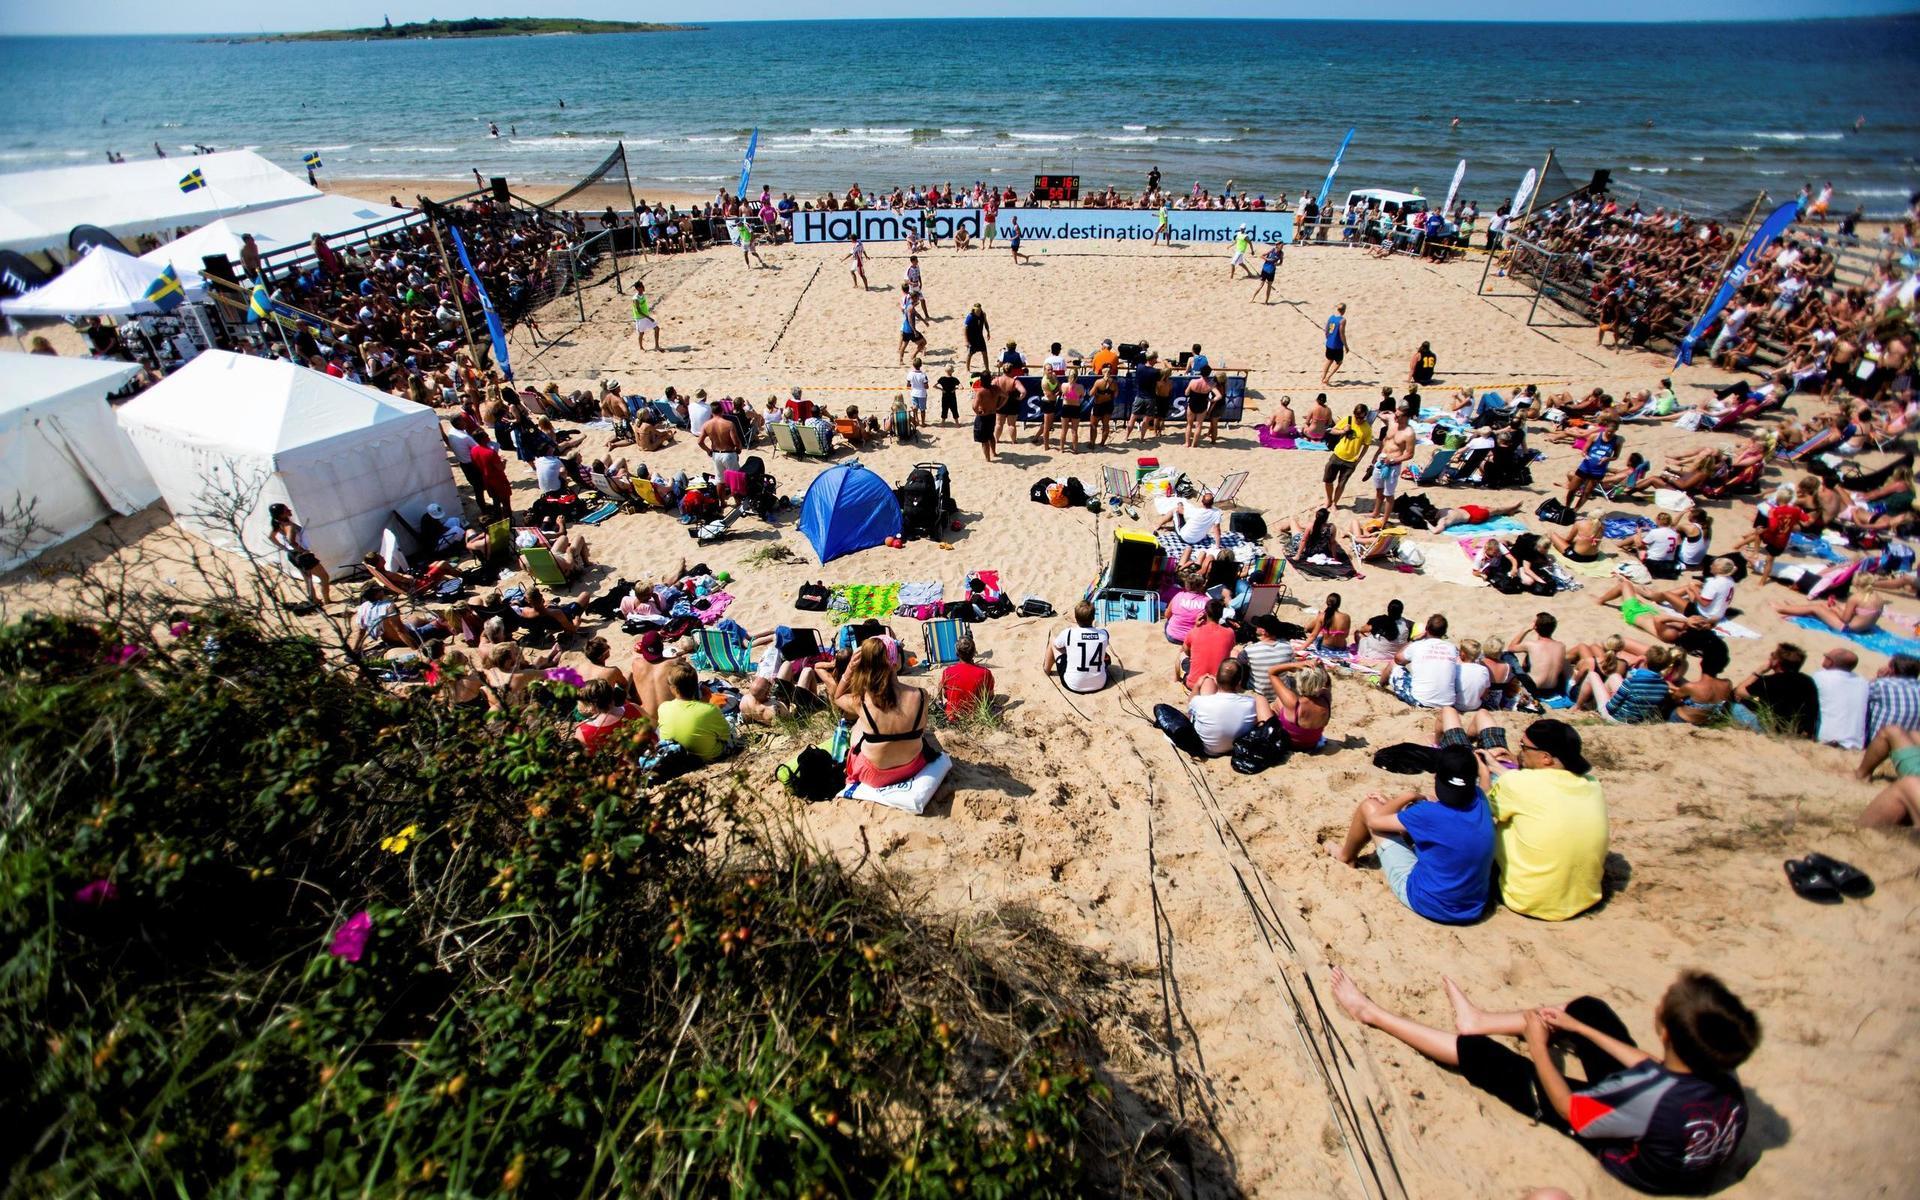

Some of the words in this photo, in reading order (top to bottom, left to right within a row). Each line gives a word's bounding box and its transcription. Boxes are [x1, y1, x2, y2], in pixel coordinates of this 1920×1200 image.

[804, 210, 980, 240] Halmstad
[1000, 223, 1283, 243] www.destinatiohalmstd.se
[1077, 642, 1103, 672] 14
